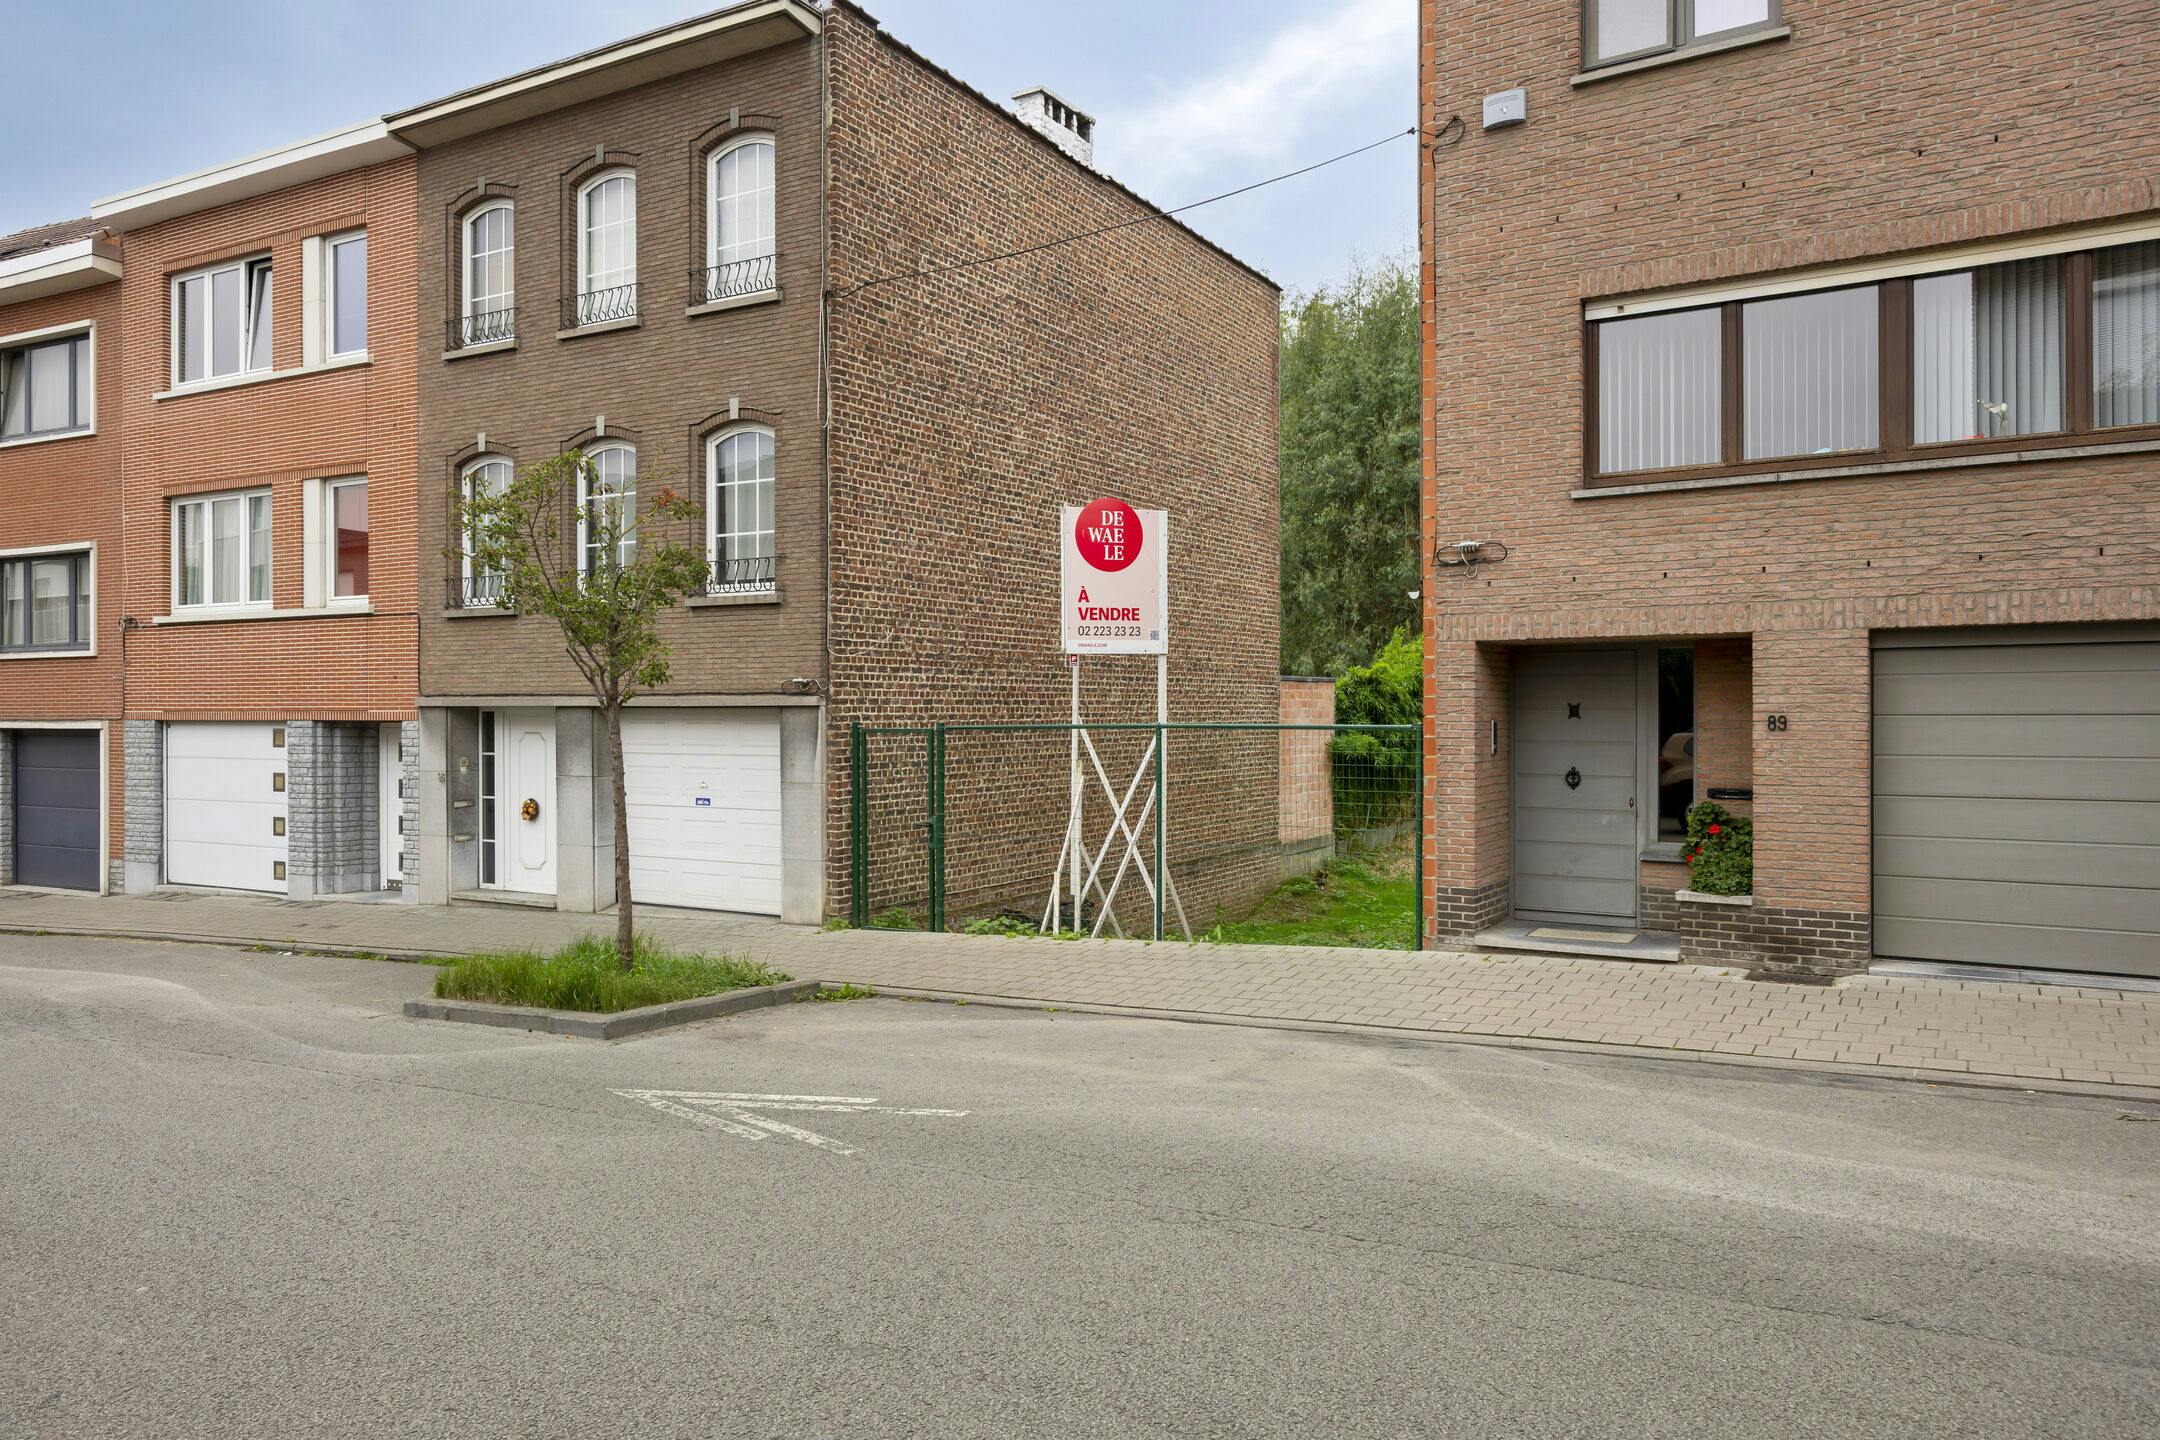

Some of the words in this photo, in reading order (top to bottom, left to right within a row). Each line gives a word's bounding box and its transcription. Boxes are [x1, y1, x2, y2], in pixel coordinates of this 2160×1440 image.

[1101, 510, 1124, 526] DE
[1088, 527, 1124, 543] WAE
[1104, 545, 1124, 560] LE
[1078, 586, 1090, 603] À
[1078, 607, 1140, 621] VENDRE
[1077, 625, 1091, 636] 02
[1093, 625, 1112, 636] 223
[1114, 626, 1127, 637] 23
[1129, 626, 1141, 637] 23
[1767, 715, 1787, 731] 89
